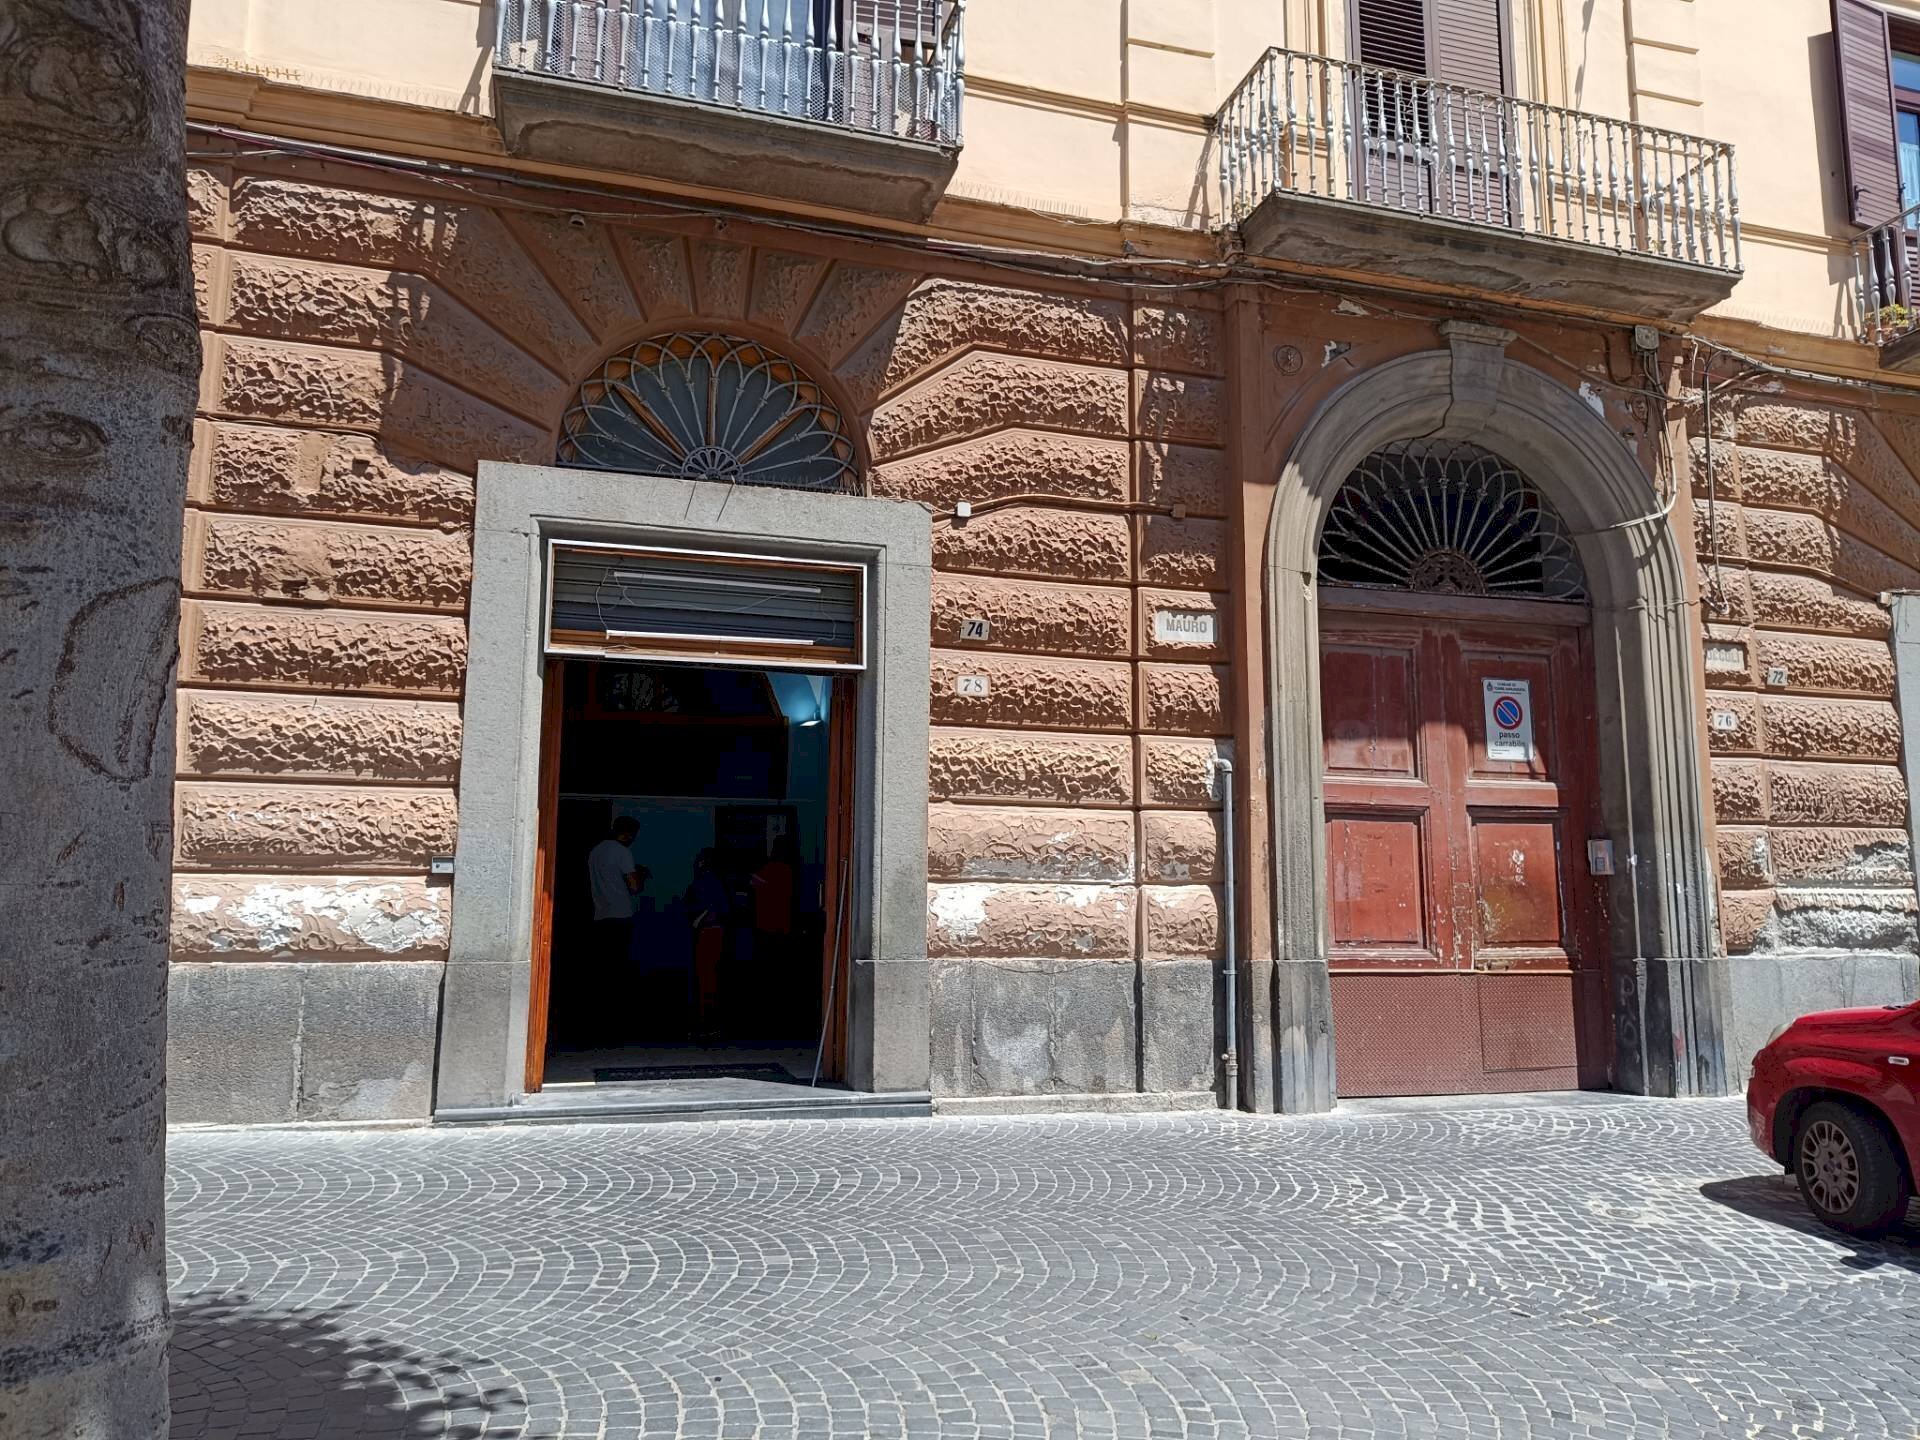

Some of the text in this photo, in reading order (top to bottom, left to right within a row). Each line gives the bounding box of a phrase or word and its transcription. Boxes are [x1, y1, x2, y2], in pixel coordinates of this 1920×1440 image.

[967, 621, 983, 637] 74
[1166, 618, 1207, 633] MAURO
[1772, 670, 1784, 684] 72
[963, 679, 982, 692] 78
[1718, 714, 1732, 726] 76
[1499, 731, 1520, 740] passo
